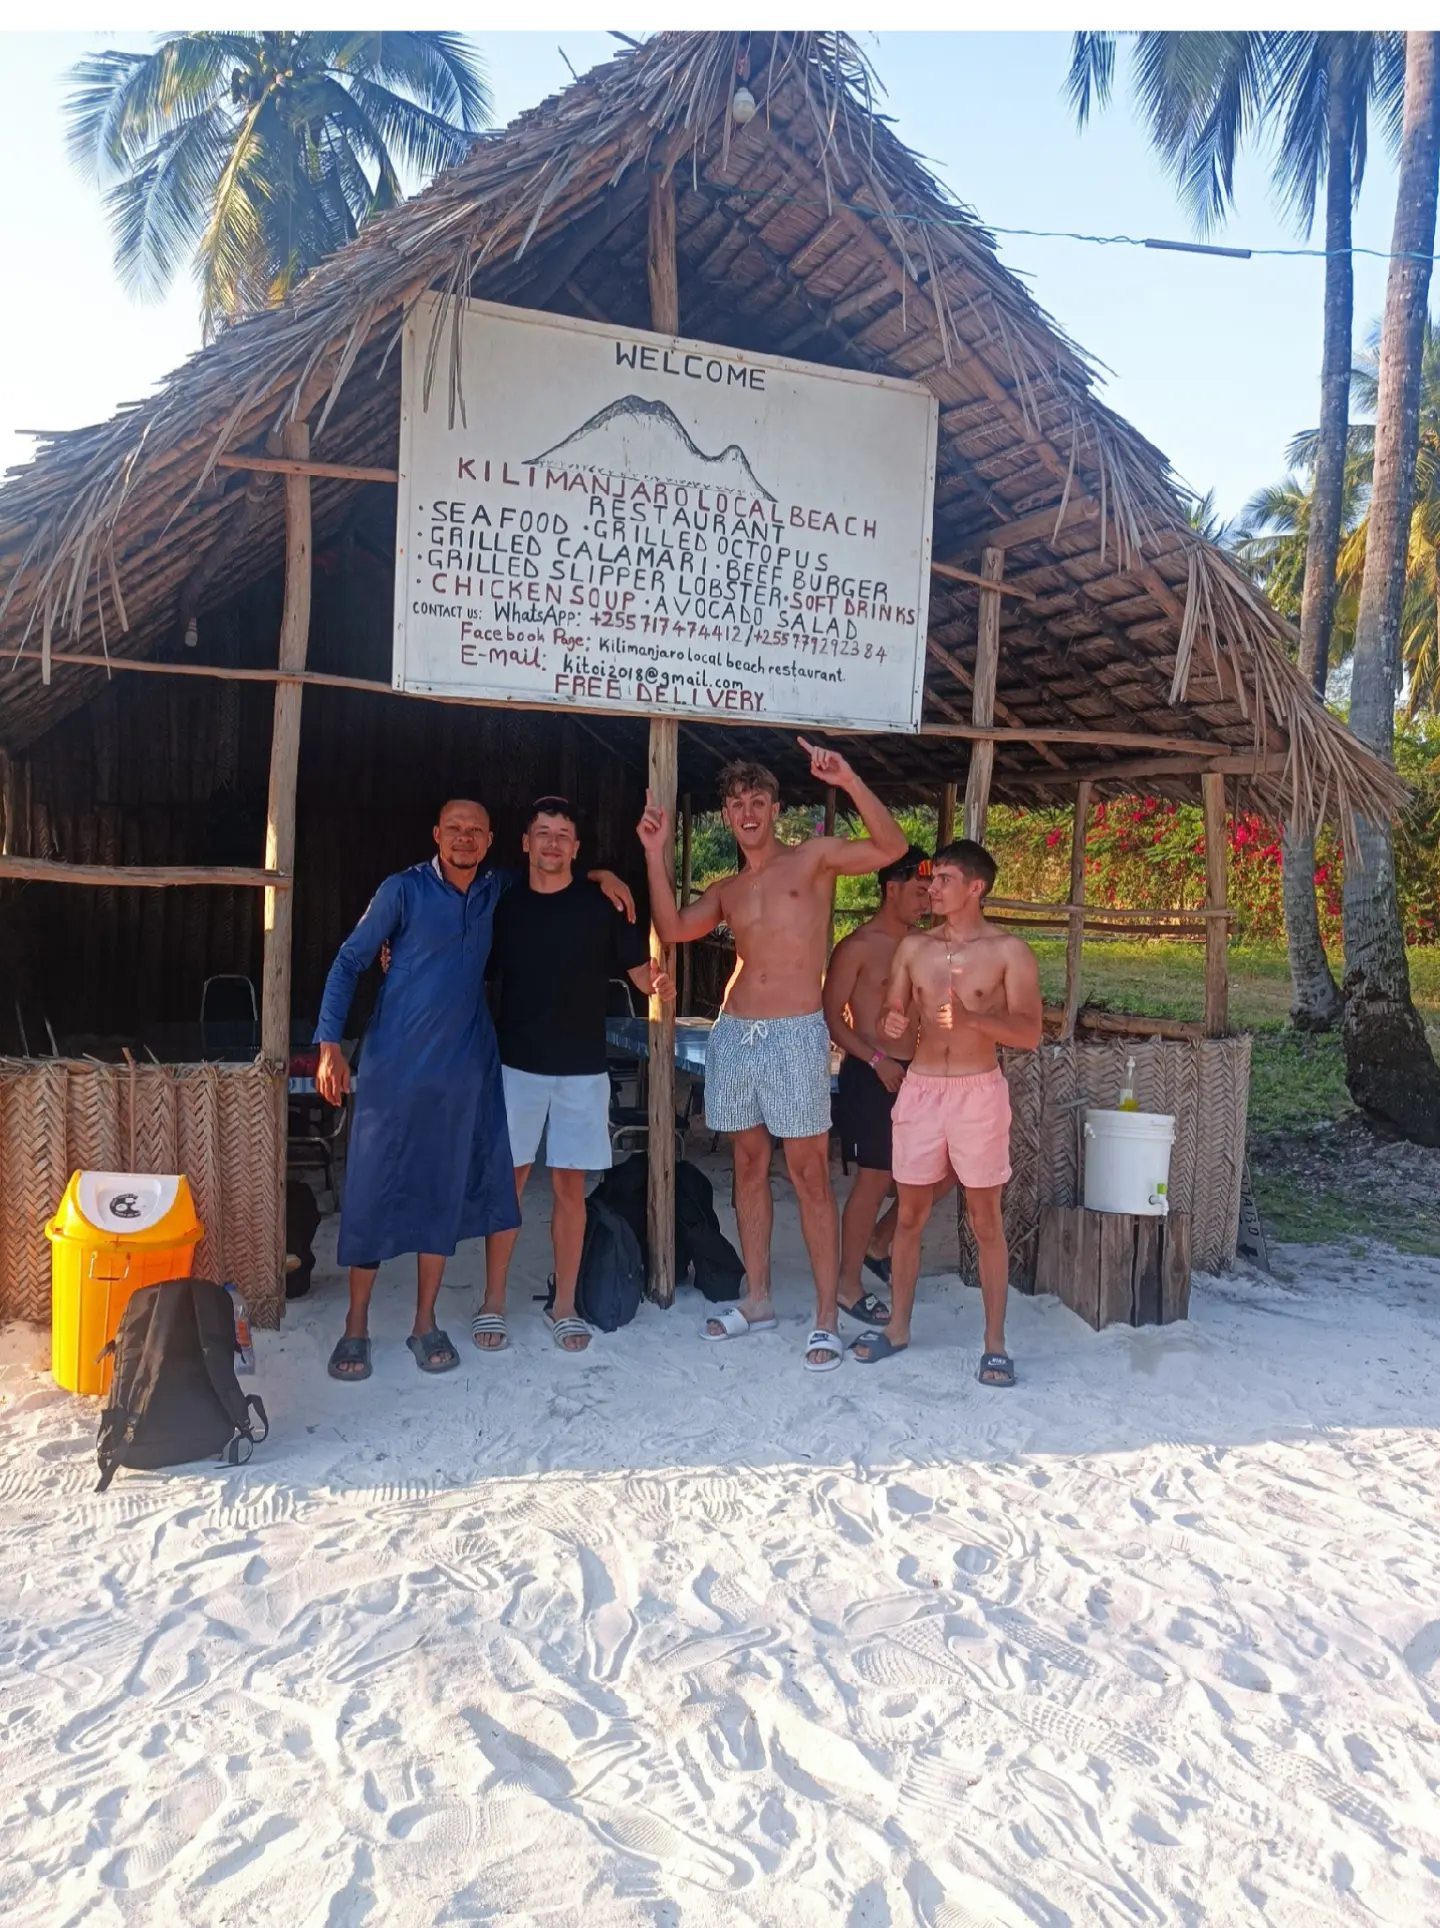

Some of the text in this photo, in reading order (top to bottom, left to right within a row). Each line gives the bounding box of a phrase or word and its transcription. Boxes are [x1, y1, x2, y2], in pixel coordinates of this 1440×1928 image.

[616, 341, 766, 391] WELCOME
[458, 457, 877, 539] KILIMANJARO LOCAL BEACH
[589, 496, 785, 544] RESTAURANT
[431, 526, 888, 602] GRILLED CALAMARI BEEF BURGER
[594, 520, 707, 551] GRILLED
[718, 536, 829, 572] OCTOPUS
[413, 601, 463, 619] CONTACT
[428, 549, 916, 626] GRILLED SLIPPER LOBSTER SOFT DRINKS
[432, 573, 858, 640] CHICKEN SOUP AVOCADO SALAD
[461, 621, 545, 643] Facebook
[553, 628, 591, 653] Page:
[599, 637, 684, 661] Kilimanjaro
[687, 647, 722, 667] local
[726, 652, 765, 675] beach
[563, 654, 744, 690] kitoi2018@gmail.com
[555, 674, 621, 700] FREE
